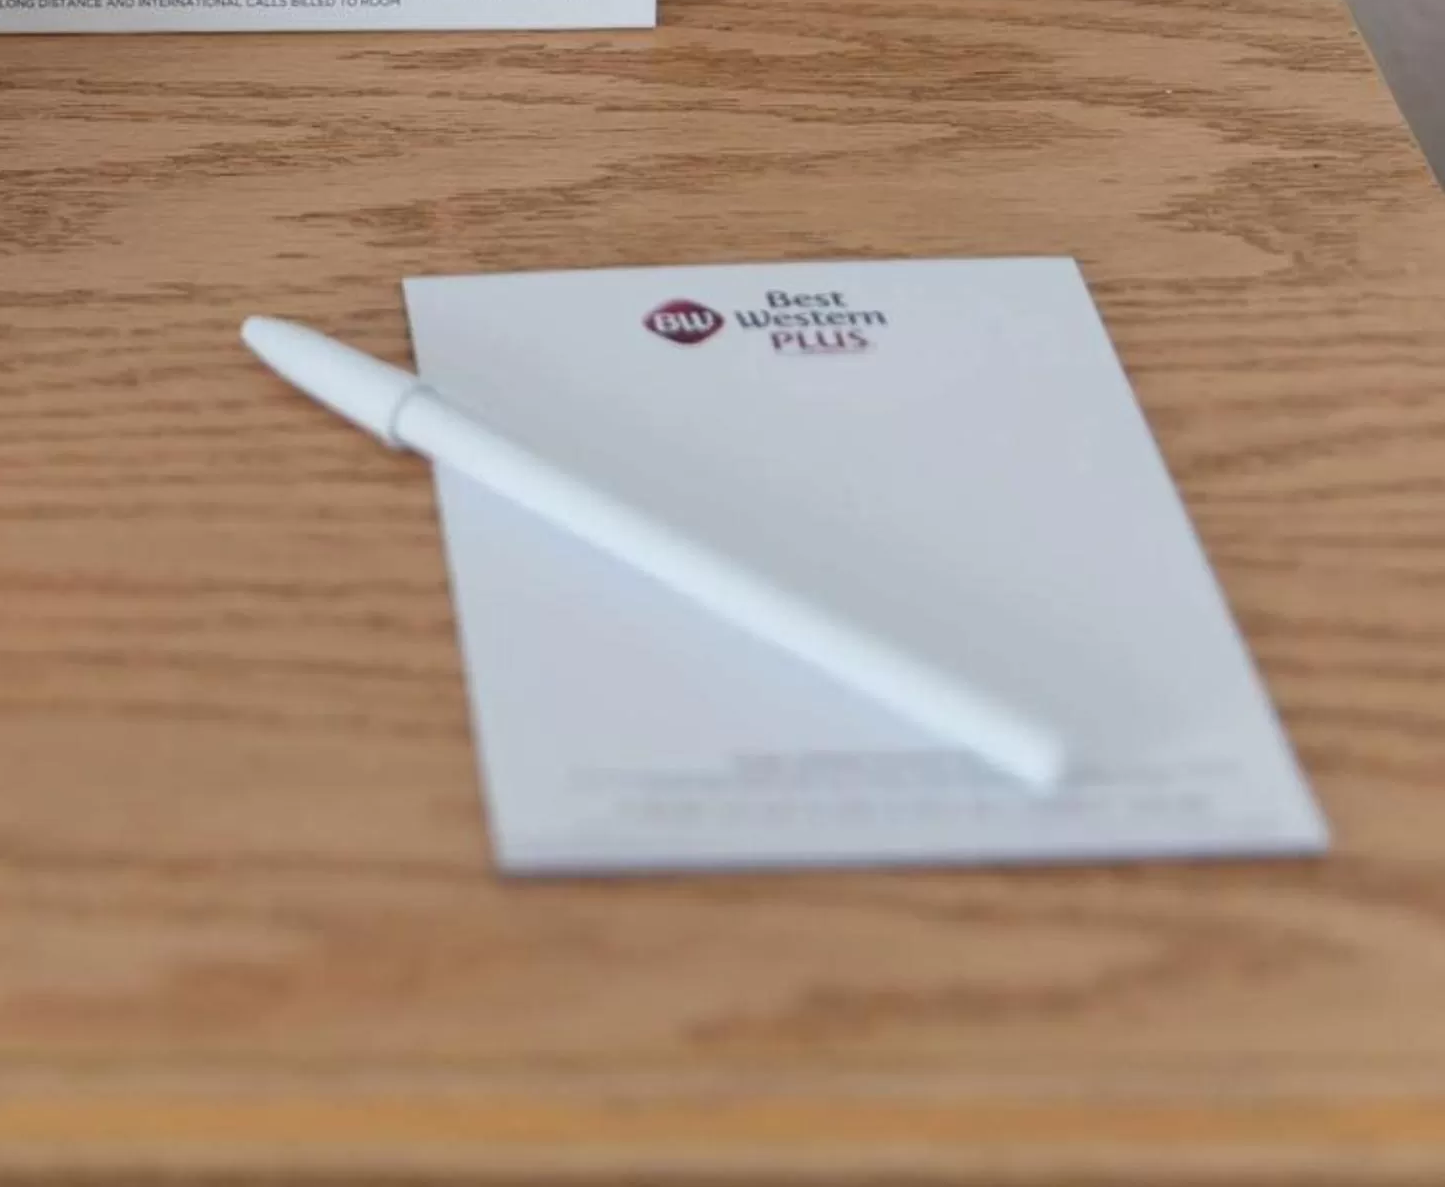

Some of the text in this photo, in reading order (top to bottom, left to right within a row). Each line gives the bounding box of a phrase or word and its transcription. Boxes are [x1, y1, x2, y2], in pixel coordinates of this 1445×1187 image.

[764, 289, 847, 309] Best
[655, 310, 714, 334] BW
[733, 309, 889, 330] Western
[770, 330, 870, 351] PLUS
